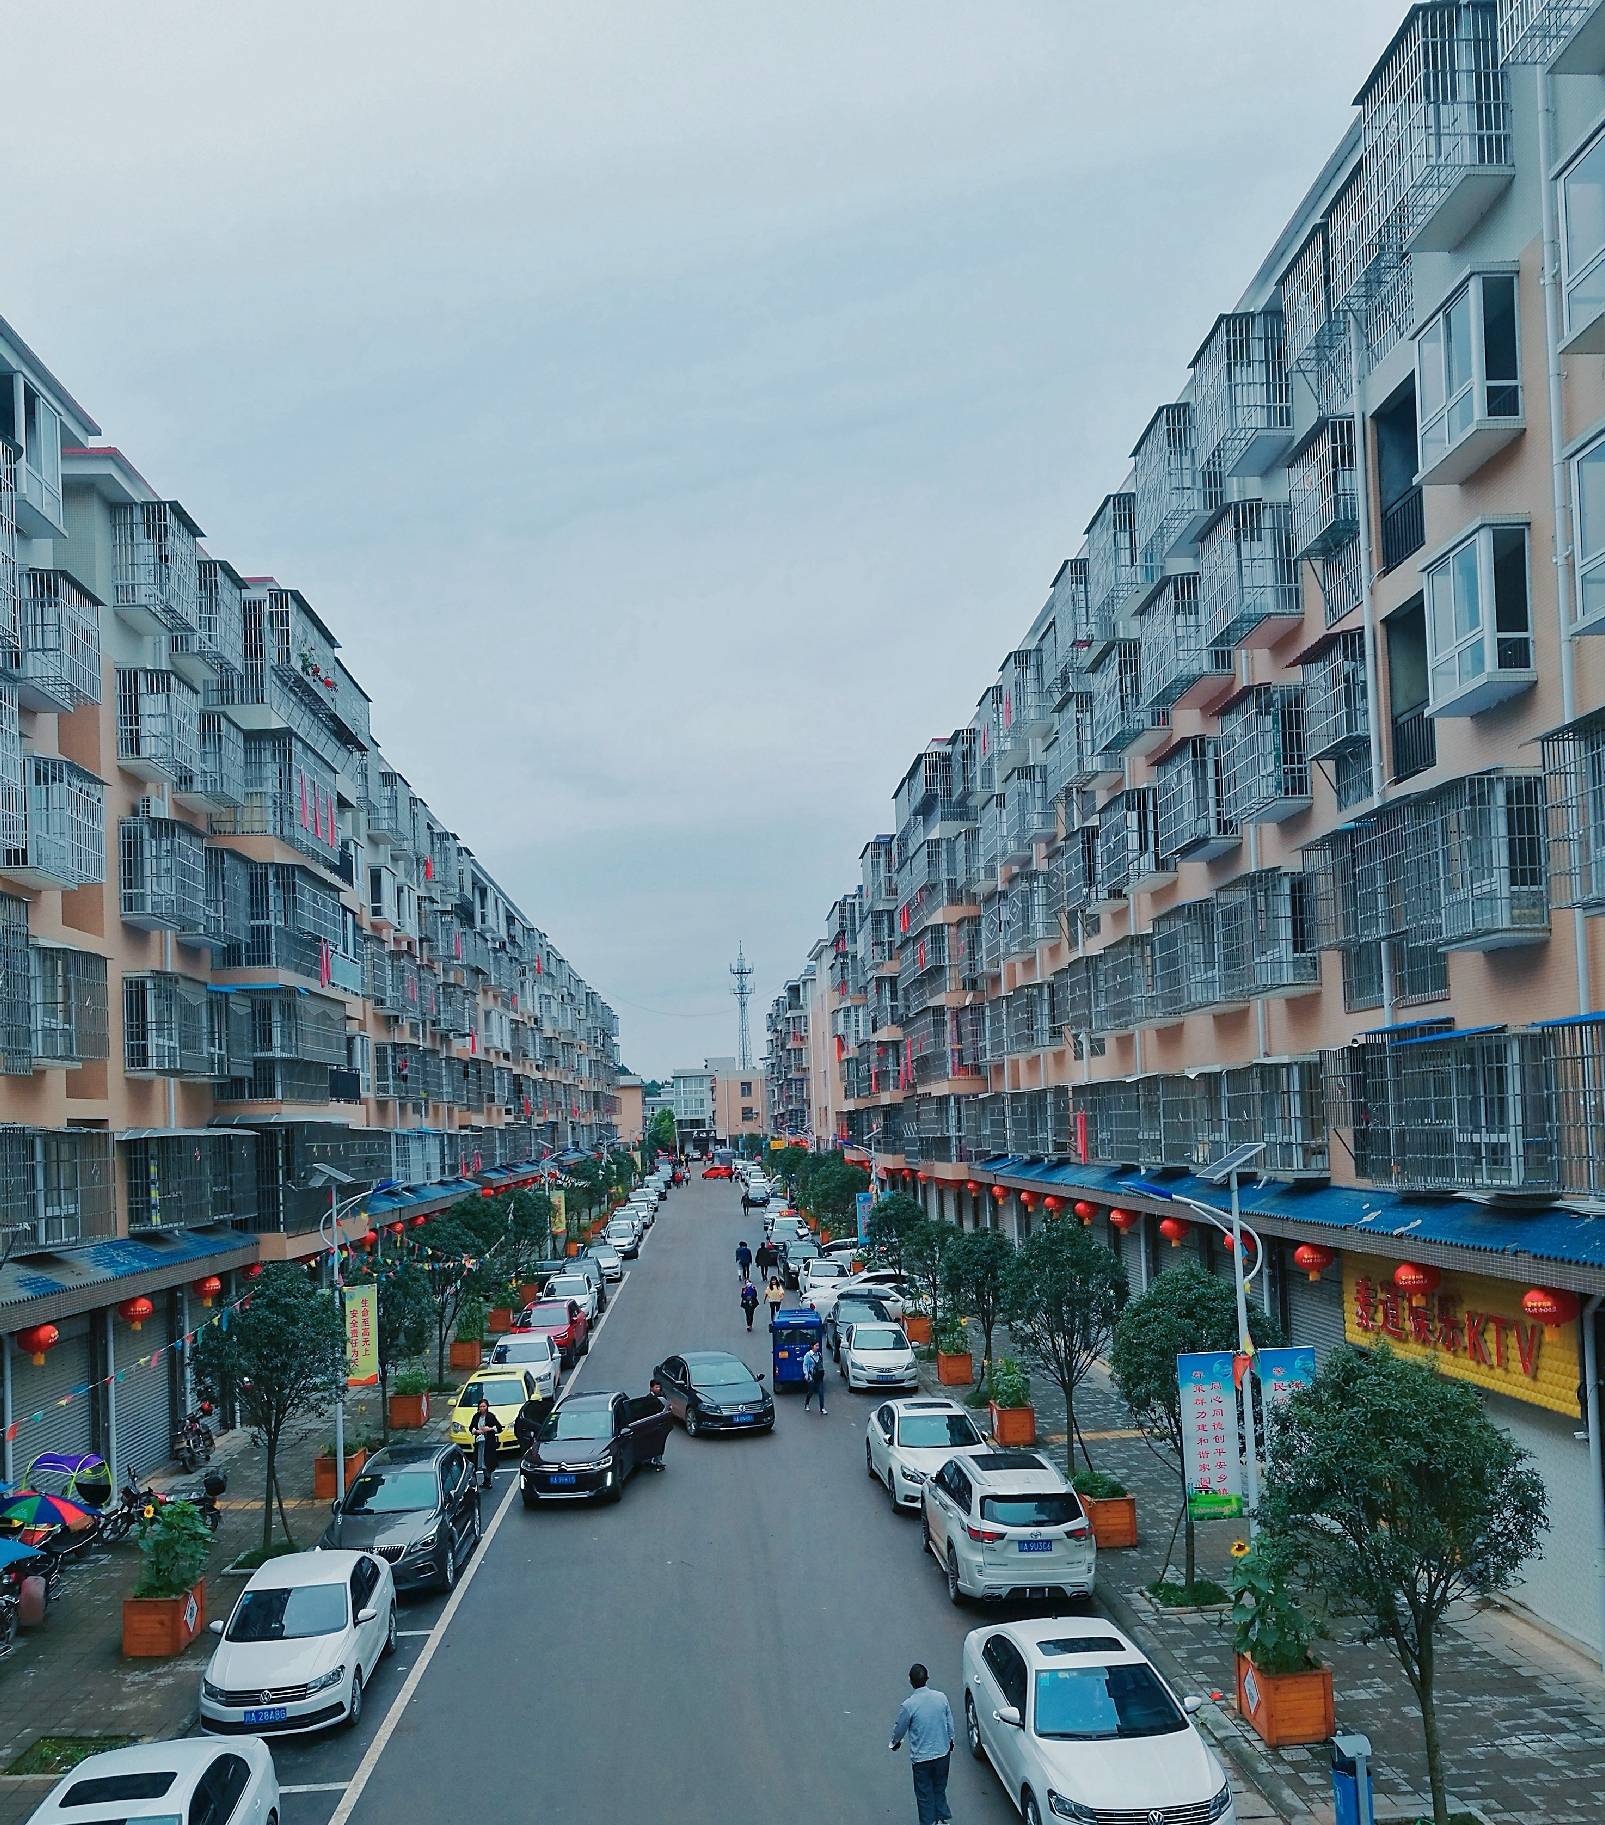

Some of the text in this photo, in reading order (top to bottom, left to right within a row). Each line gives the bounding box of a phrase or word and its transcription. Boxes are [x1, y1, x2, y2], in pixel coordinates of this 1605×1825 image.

[350, 1309, 359, 1368] 安全责任为天
[361, 1298, 370, 1357] 生命至高无上
